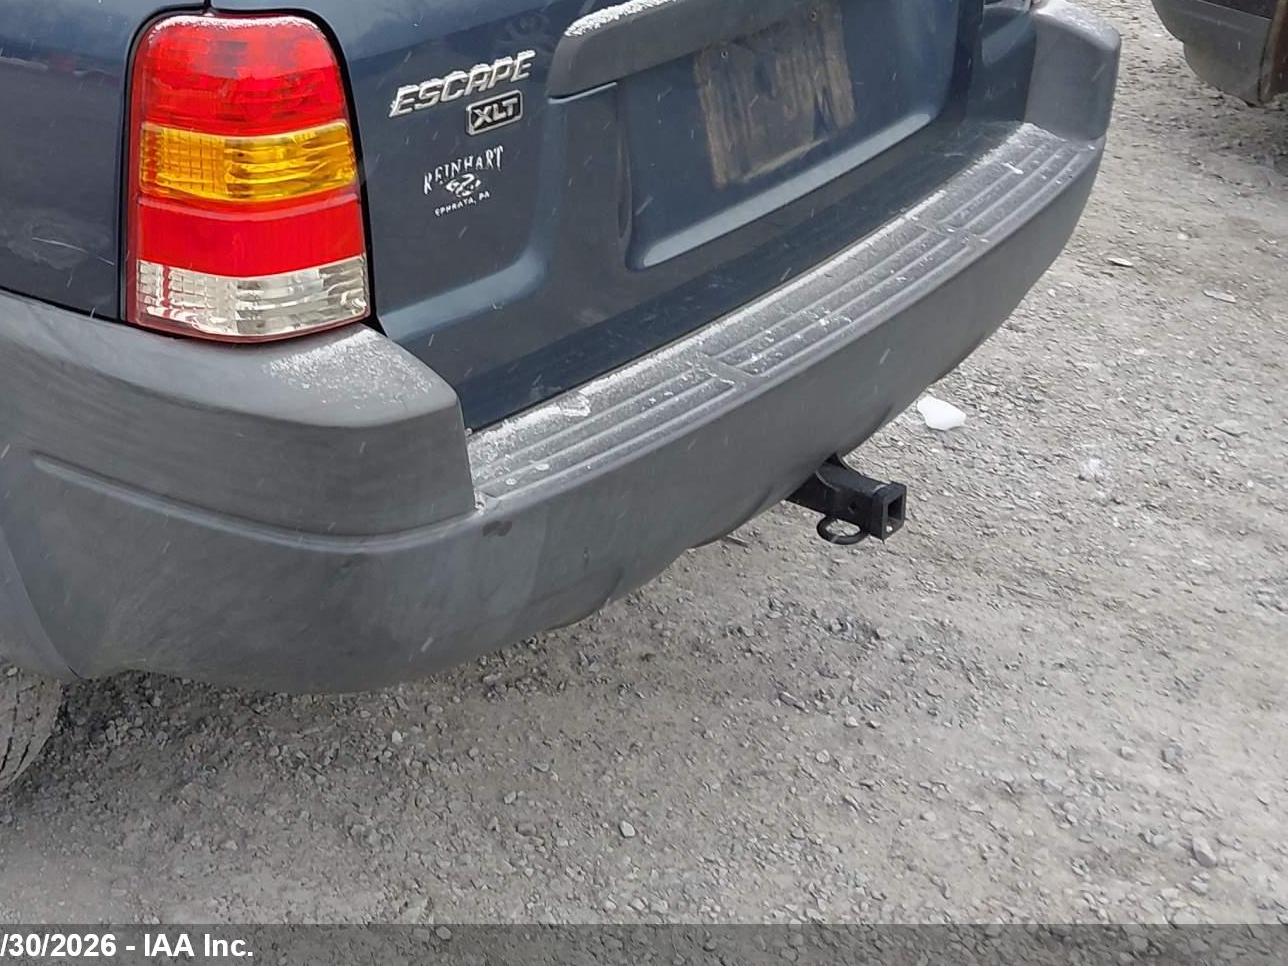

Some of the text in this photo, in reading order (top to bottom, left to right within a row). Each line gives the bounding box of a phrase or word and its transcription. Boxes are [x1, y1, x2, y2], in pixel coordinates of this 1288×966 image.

[389, 50, 536, 118] ESCAPE
[471, 97, 519, 129] XLT
[424, 145, 504, 195] REINHART
